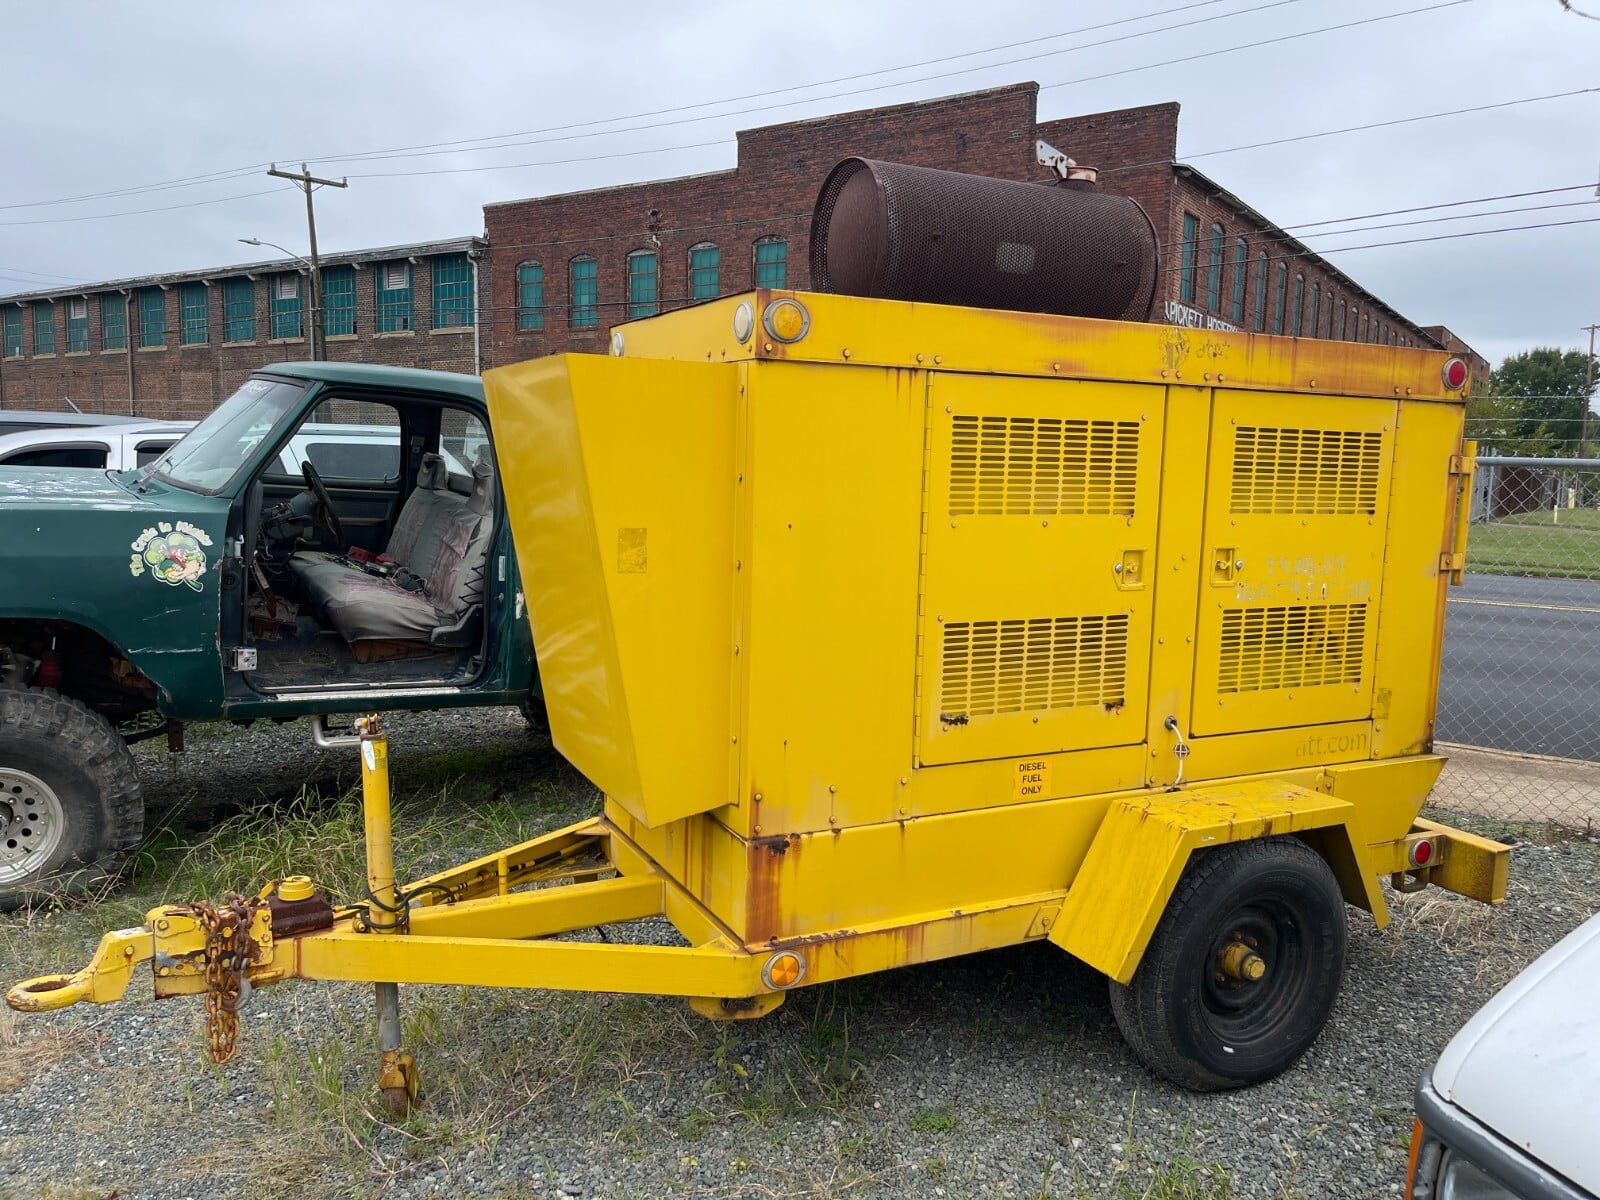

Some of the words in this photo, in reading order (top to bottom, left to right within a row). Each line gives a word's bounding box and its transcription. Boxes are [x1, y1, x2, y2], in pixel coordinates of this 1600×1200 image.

[1170, 301, 1203, 329] PICKETT
[1018, 761, 1047, 772] DIESEL
[1022, 774, 1042, 784] FUEL
[1021, 785, 1042, 796] ONLY
